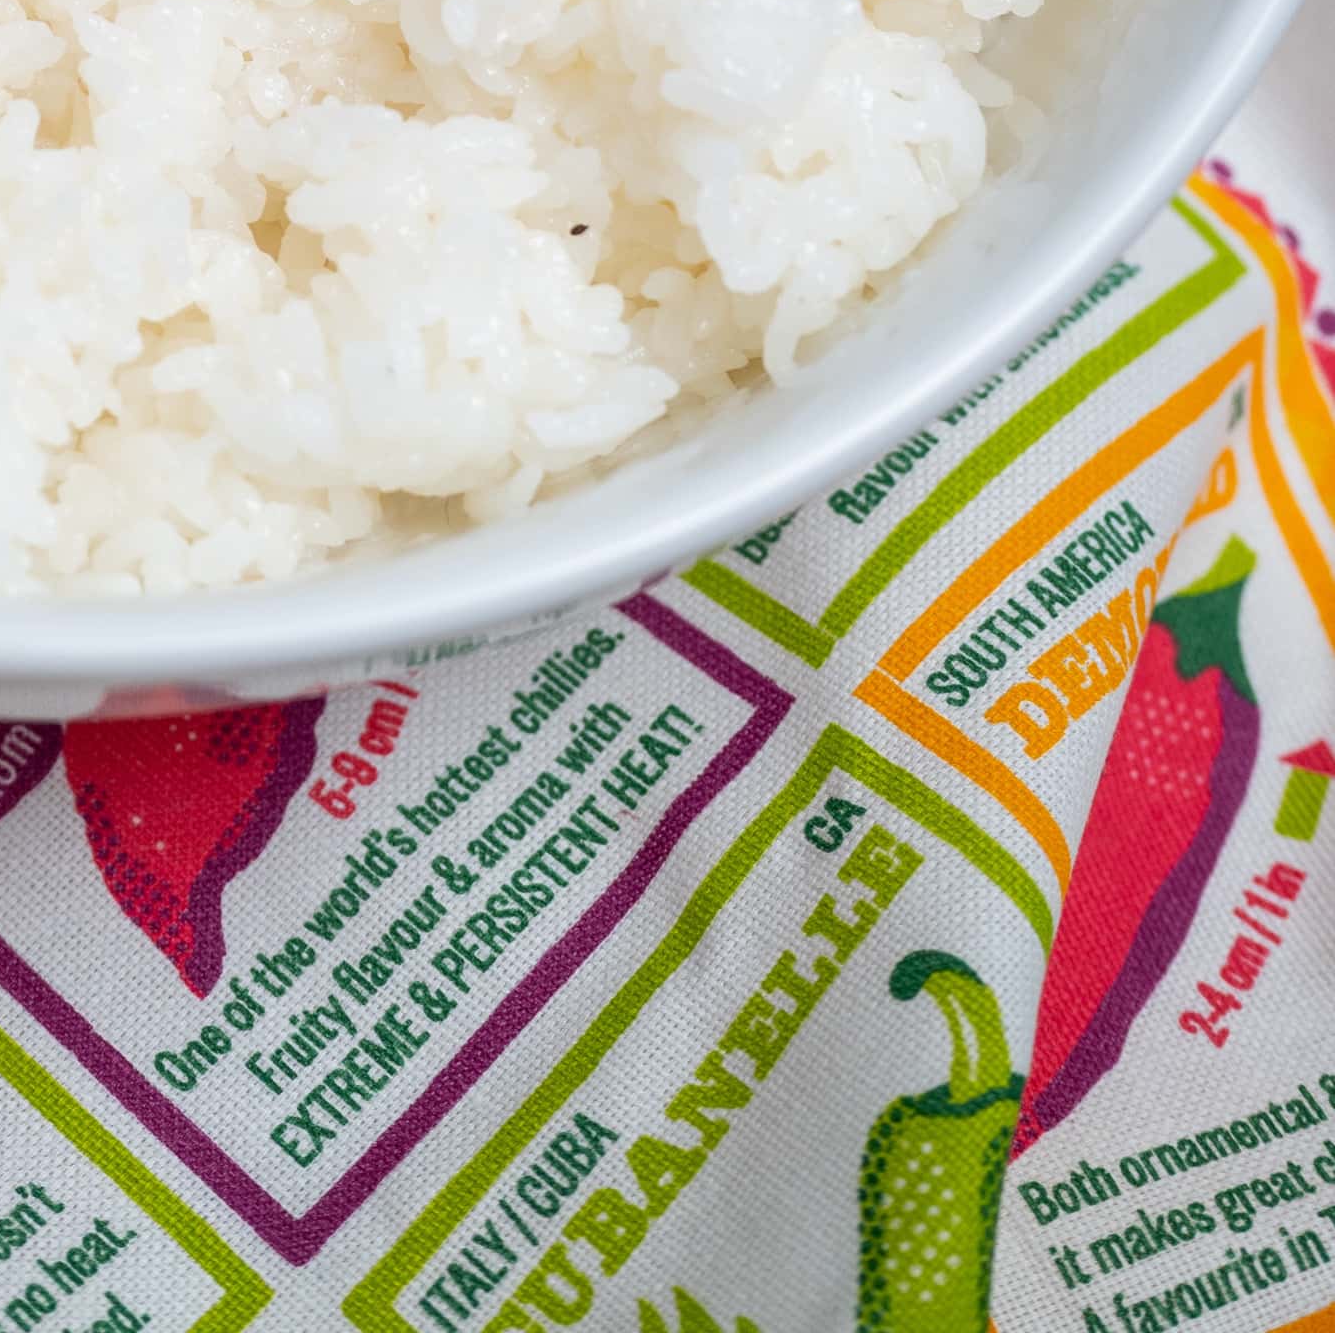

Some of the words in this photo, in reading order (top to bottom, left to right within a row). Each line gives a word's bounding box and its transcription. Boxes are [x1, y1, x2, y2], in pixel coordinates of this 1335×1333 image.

[926, 598, 1045, 707] SOUTH
[1027, 501, 1154, 618] AMERICA
[358, 699, 409, 757] cm
[602, 705, 703, 810] HEAT!
[154, 1025, 232, 1092] One
[223, 977, 266, 1031] of
[251, 937, 316, 997] the
[304, 817, 419, 941] world's
[397, 726, 522, 836] hottest
[509, 627, 625, 750] chillies.
[805, 799, 866, 851] CA
[245, 995, 358, 1094] Fruity
[332, 885, 447, 1006] flavour
[431, 856, 480, 895] &
[468, 772, 570, 869] aroma
[556, 703, 631, 774] with
[431, 795, 620, 993] PERSISTENT
[408, 980, 458, 1022] &
[1179, 982, 1242, 1049] 2-4
[1220, 935, 1270, 991] cm
[270, 1004, 430, 1168] EXTREME
[516, 1113, 618, 1218] CUBA
[1018, 1161, 1120, 1225] Both
[1120, 1085, 1327, 1187] ornamental
[4, 1283, 58, 1333] no
[37, 1219, 137, 1294] heat.
[419, 1220, 518, 1333] ITALY
[499, 1199, 538, 1246] /
[1049, 1247, 1092, 1288] it
[1090, 1202, 1216, 1274] makes
[1215, 1162, 1316, 1233] great
[1114, 1248, 1287, 1333] favourite
[1282, 1230, 1330, 1271] in
